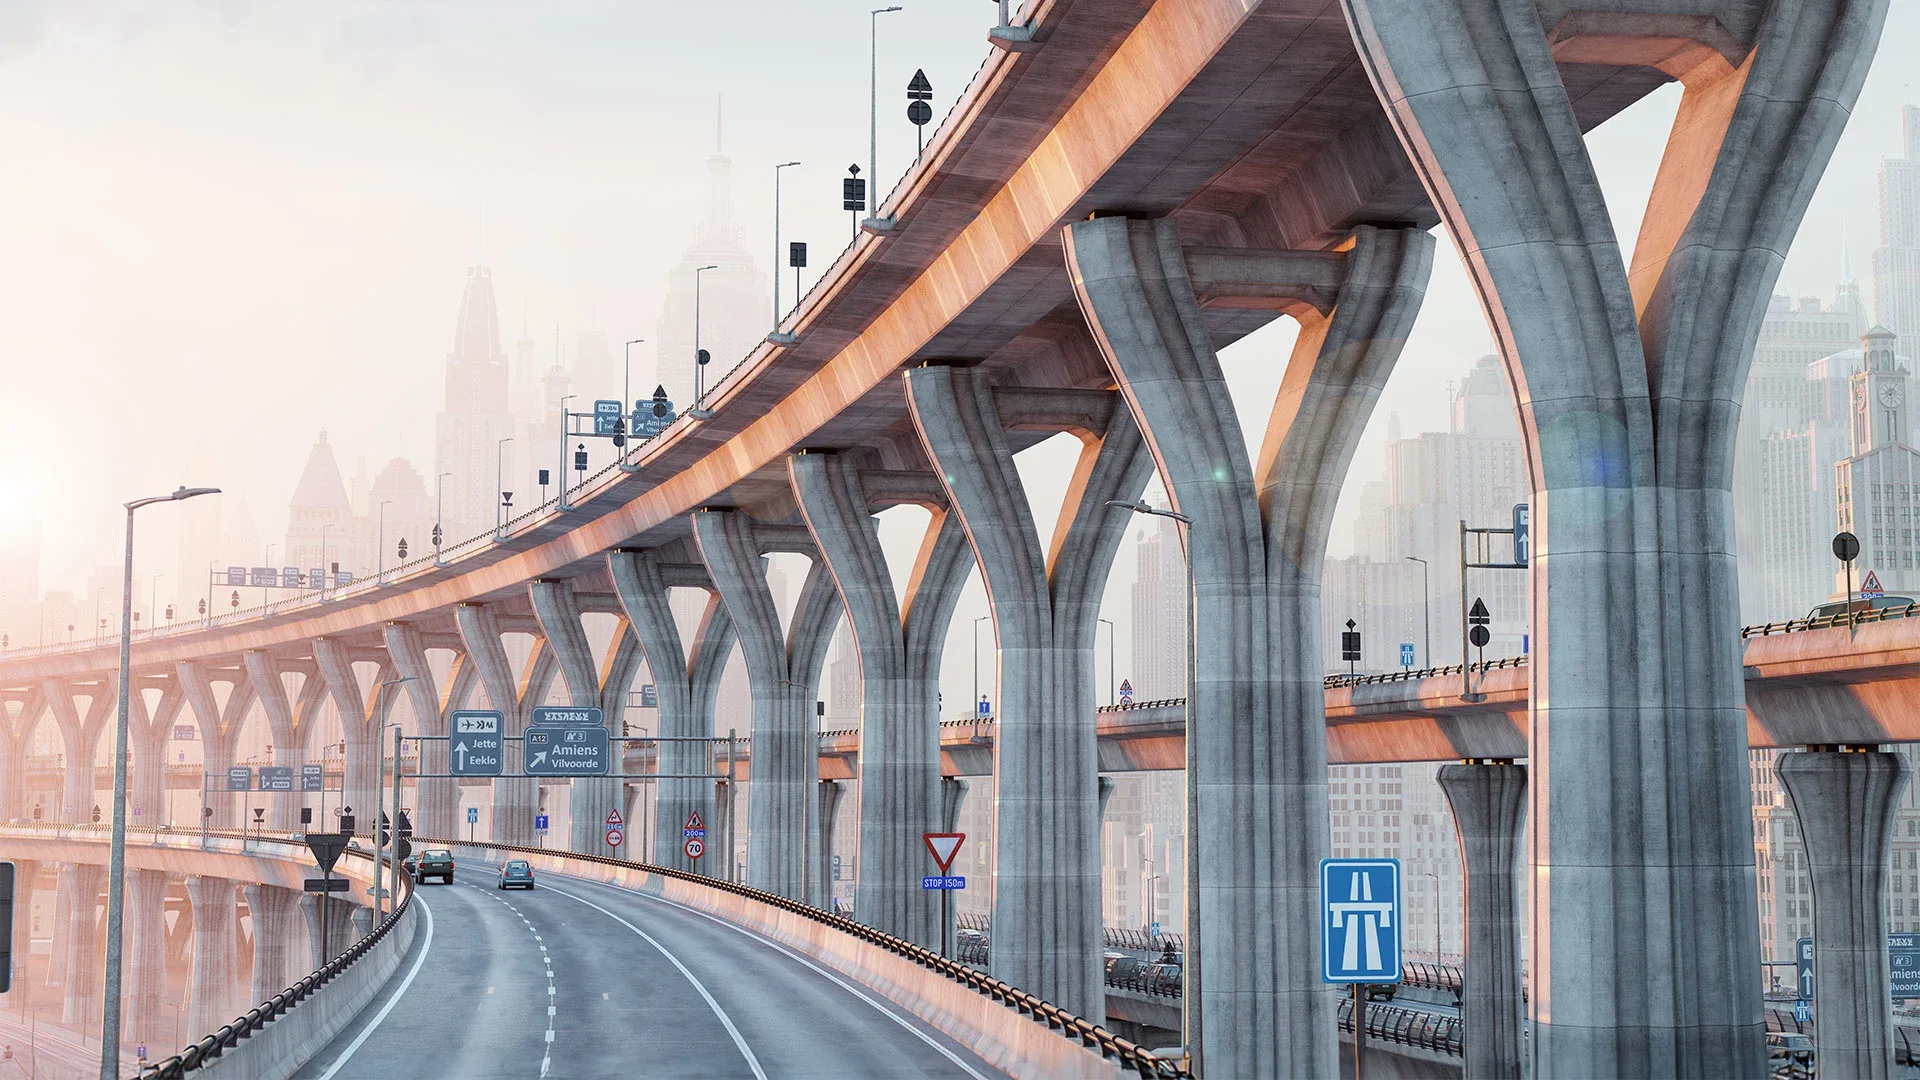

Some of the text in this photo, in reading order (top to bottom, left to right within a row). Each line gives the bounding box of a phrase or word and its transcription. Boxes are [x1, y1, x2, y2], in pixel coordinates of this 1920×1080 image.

[531, 735, 547, 743] A12
[577, 733, 583, 741] 3
[472, 739, 497, 749] Jette
[552, 744, 598, 756] Amiens
[470, 755, 497, 766] Eeklo
[552, 758, 598, 769] Vilvoorde
[688, 844, 701, 853] 70
[925, 879, 964, 887] STOP 150m
[1905, 957, 1910, 965] 3
[1890, 969, 1920, 979] miens
